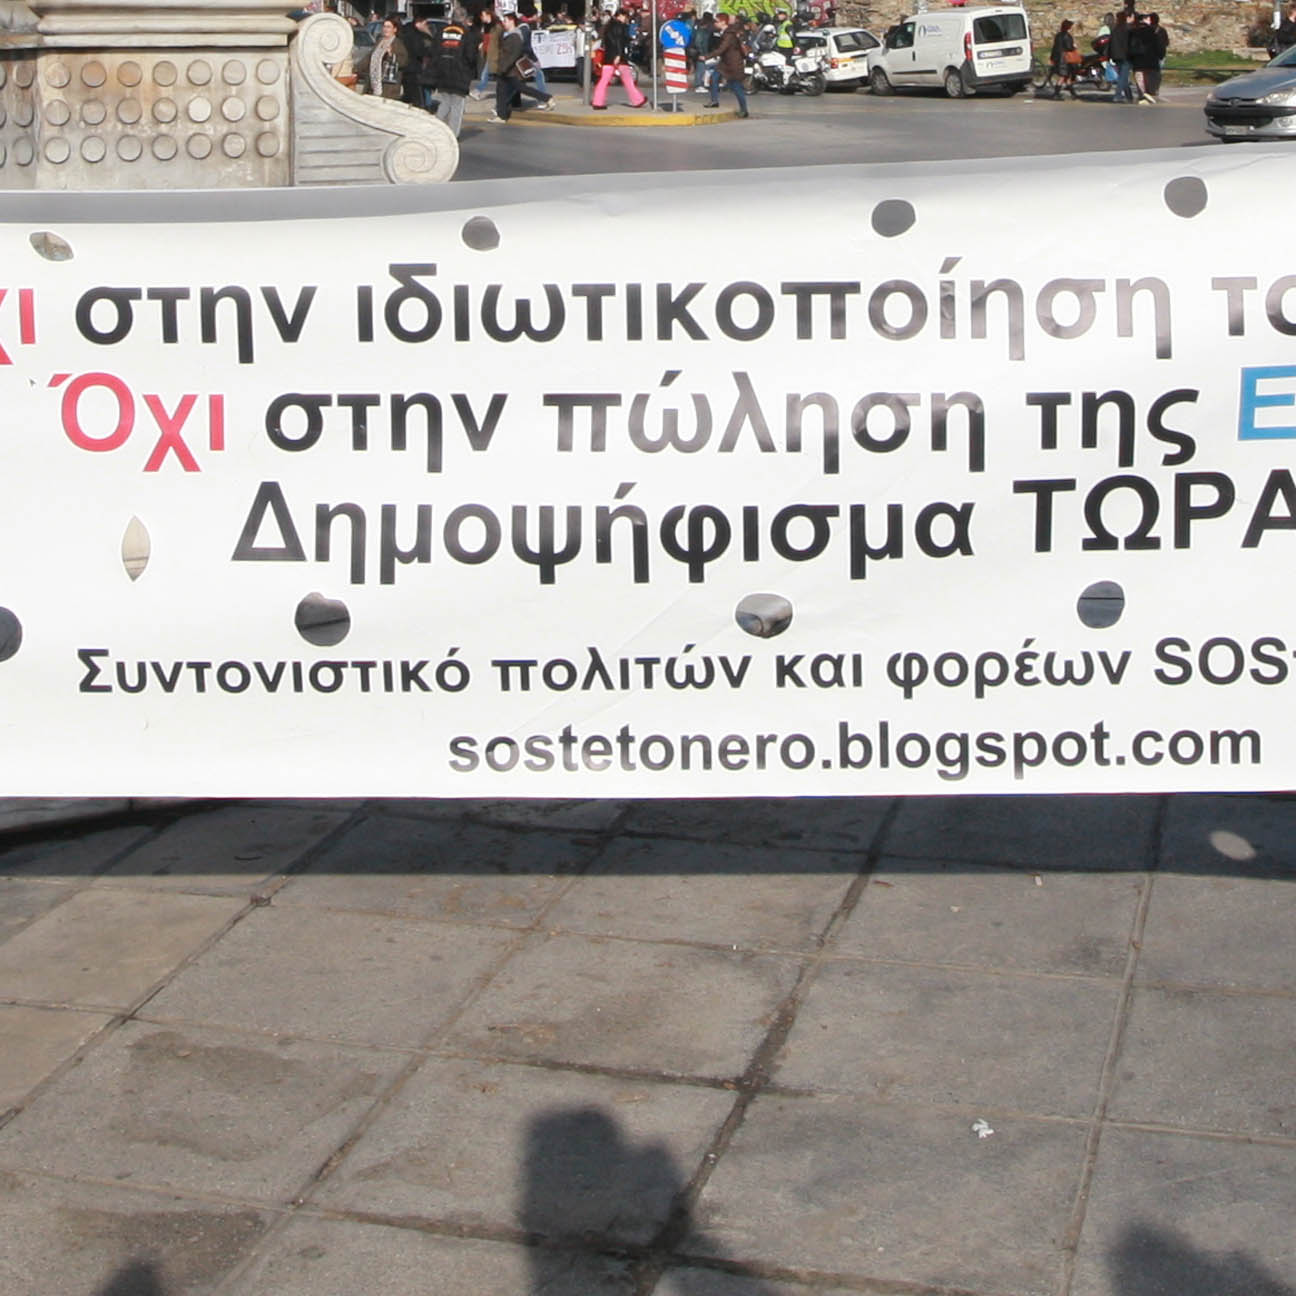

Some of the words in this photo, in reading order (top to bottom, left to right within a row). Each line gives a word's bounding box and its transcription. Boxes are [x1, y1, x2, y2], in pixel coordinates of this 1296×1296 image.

[74, 285, 318, 365] στην
[357, 256, 1173, 362] ιδιωτικοποίηση
[47, 372, 225, 473] Όχι
[264, 392, 509, 474] στην
[542, 369, 986, 475] πώληση
[1025, 388, 1201, 468] της
[230, 480, 976, 586] Δημοψήφισμα
[76, 647, 471, 694] Συντονιστικό
[490, 643, 753, 692] πολιτών
[775, 652, 863, 689] και
[886, 637, 1133, 700] φορέων
[449, 720, 1262, 782] sostetonero.blogspot.com
